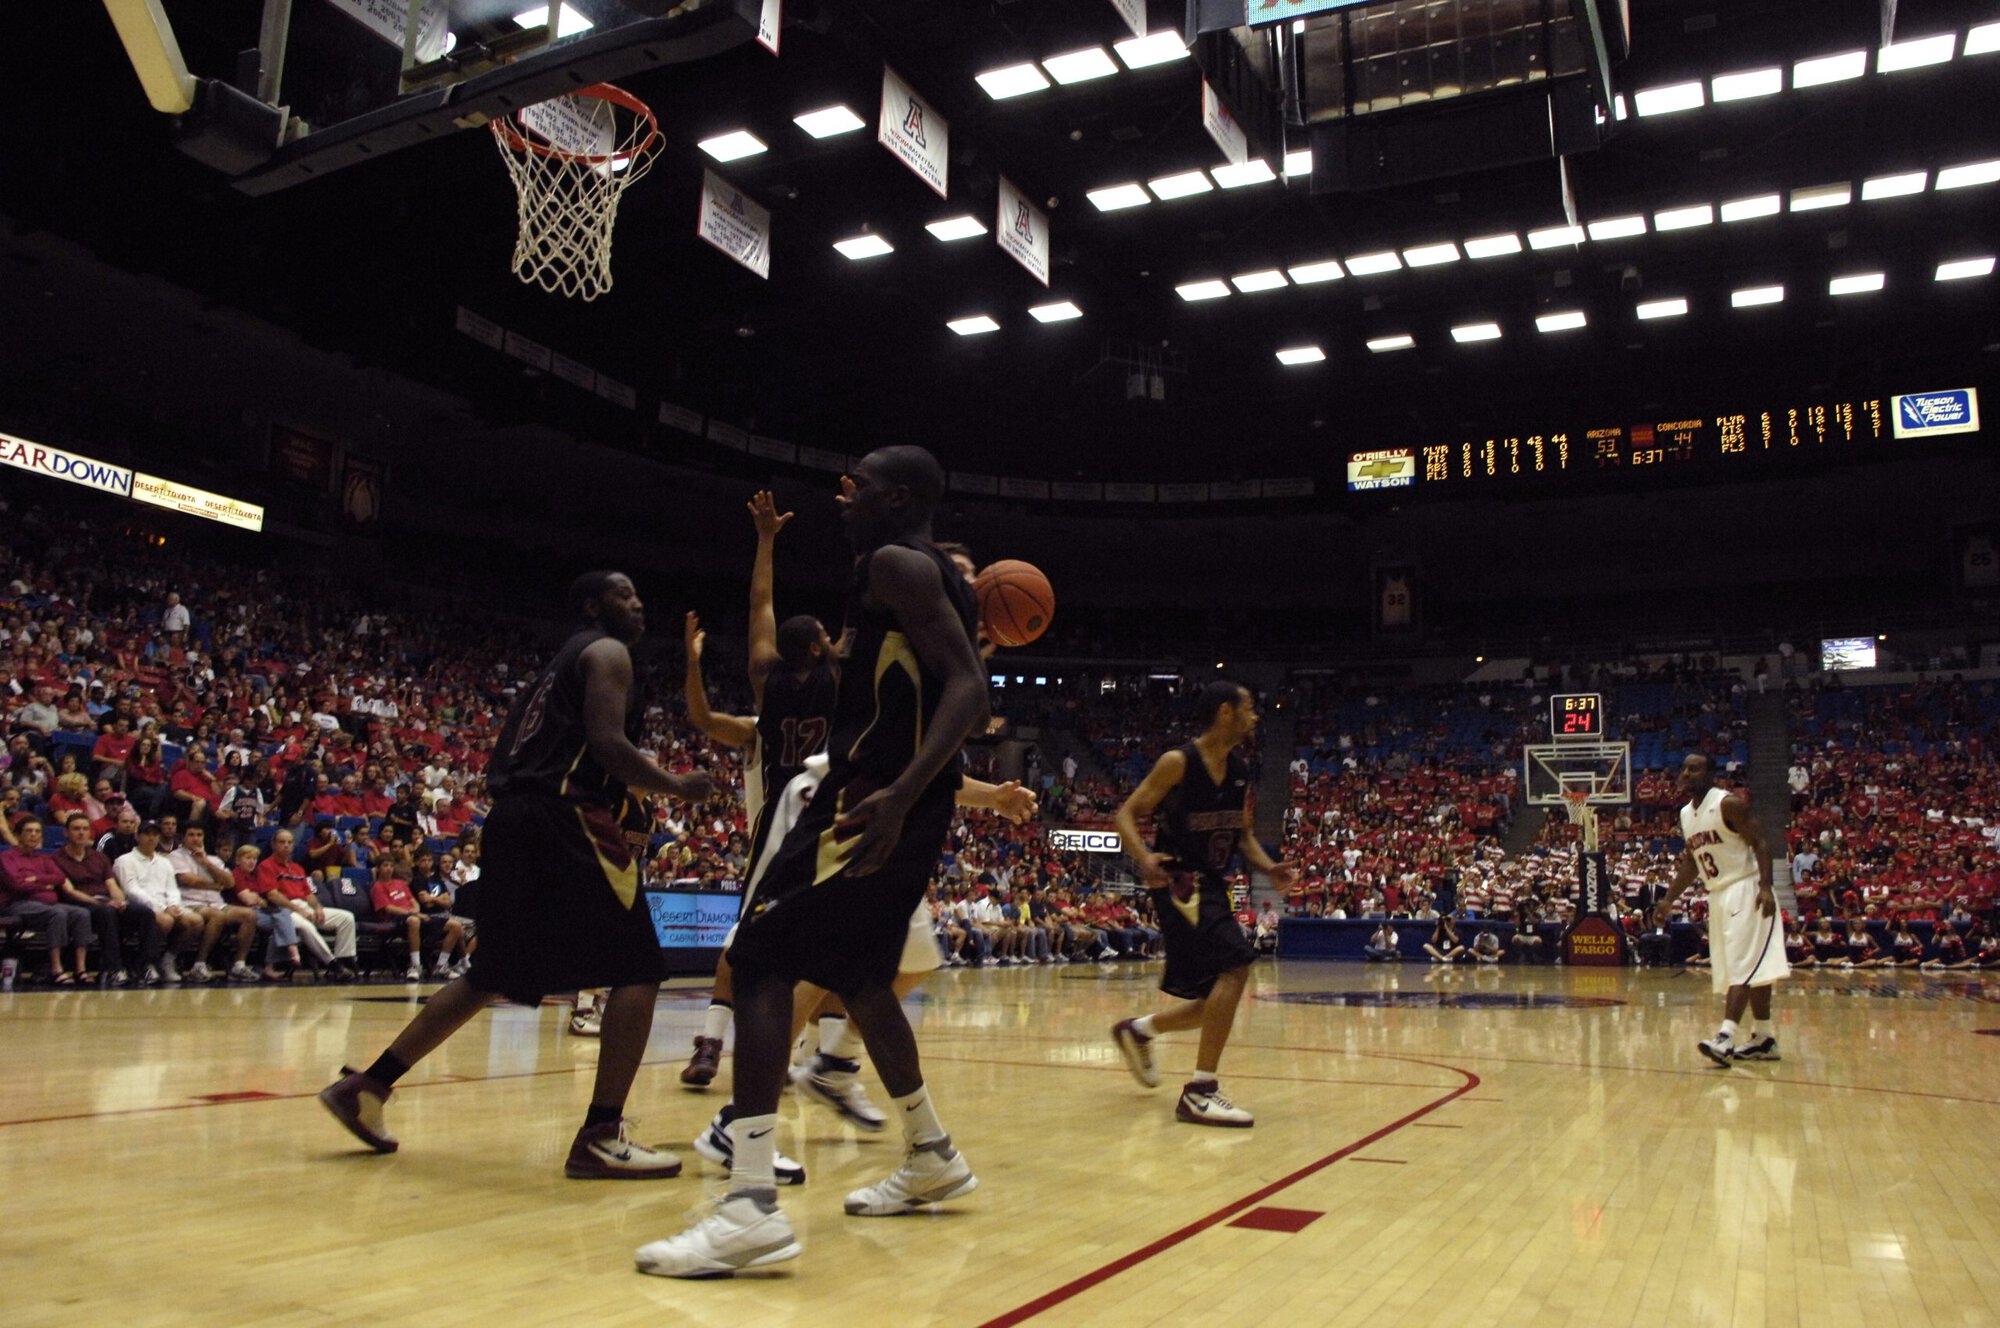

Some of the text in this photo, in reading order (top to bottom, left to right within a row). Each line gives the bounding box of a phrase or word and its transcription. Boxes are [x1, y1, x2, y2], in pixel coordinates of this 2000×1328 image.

[903, 97, 926, 149] A
[1015, 200, 1033, 245] A
[1915, 397, 1955, 407] Tucson
[1921, 403, 1963, 414] Electric
[1717, 415, 1745, 426] PLYR
[1809, 406, 1824, 417] 10
[1864, 400, 1879, 410] 15
[1925, 412, 1964, 423] Power
[1657, 419, 1703, 432] CONCORDIA
[1722, 424, 1741, 435] PTS
[1871, 410, 1880, 419] 4
[1586, 428, 1622, 439] ARIZONA
[1674, 432, 1692, 445] 44
[1463, 442, 1471, 452] 0
[1552, 434, 1567, 443] 44
[1559, 442, 1567, 451] 0
[1597, 439, 1616, 453] 53
[1722, 429, 1878, 453] FLS 1 0 1 1 1
[1353, 449, 1408, 462] O'RIELLY
[1632, 449, 1663, 465] 6:37
[1427, 471, 1448, 481] FLS
[1463, 468, 1471, 477] 0
[1487, 466, 1495, 475] 0
[1511, 464, 1519, 473] 0
[1536, 462, 1544, 471] 0
[135, 480, 164, 495] DESERT
[1354, 477, 1410, 490] WATSON
[204, 500, 232, 514] DESERT
[1387, 593, 1405, 606] 32
[1565, 697, 1595, 711] 6:37
[1564, 713, 1592, 732] 24
[780, 716, 827, 767] 12
[1053, 833, 1121, 849] GEICO
[1698, 851, 1719, 880] 13
[1586, 856, 1598, 913] ARIZONA
[652, 908, 693, 922] DESERT
[1572, 935, 1615, 945] WELLS
[1573, 945, 1615, 955] FARGO
